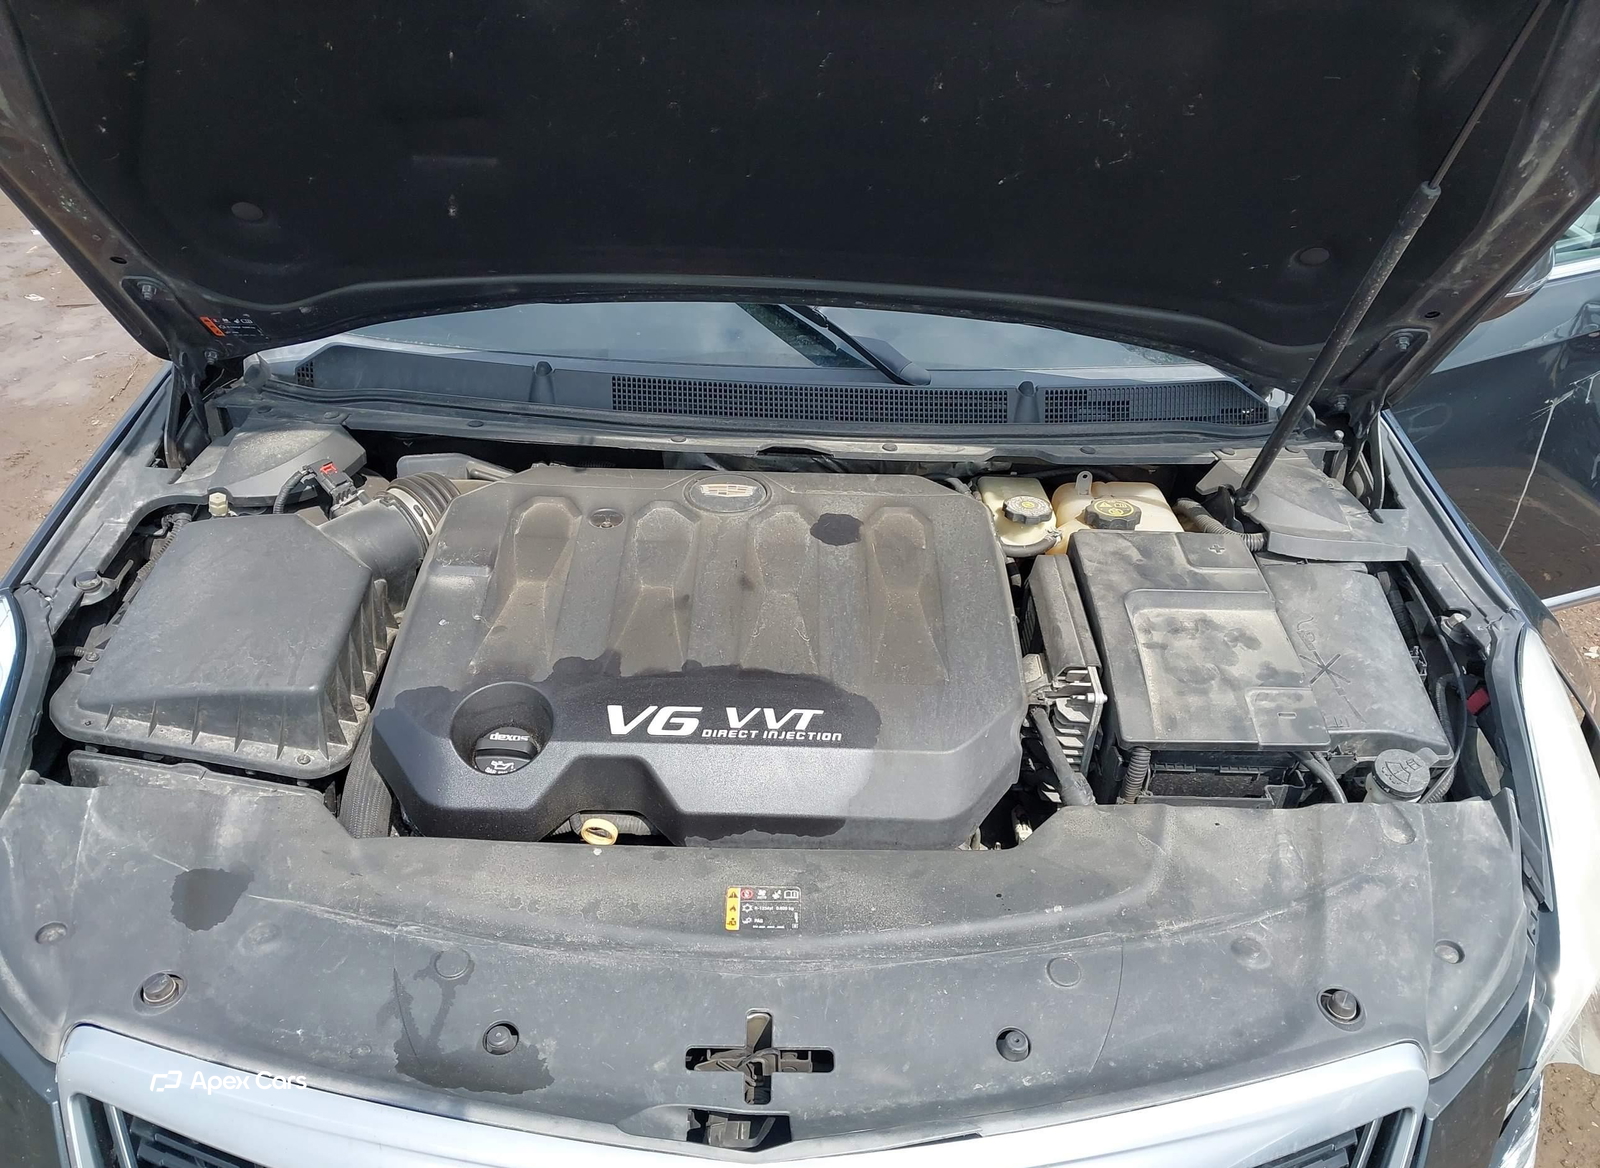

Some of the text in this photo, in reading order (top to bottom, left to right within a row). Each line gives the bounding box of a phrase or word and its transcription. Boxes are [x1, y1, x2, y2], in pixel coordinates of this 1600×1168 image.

[607, 705, 824, 736] V6 VVT
[489, 732, 530, 741] dexos
[702, 729, 842, 742] DIRECT INJECTION
